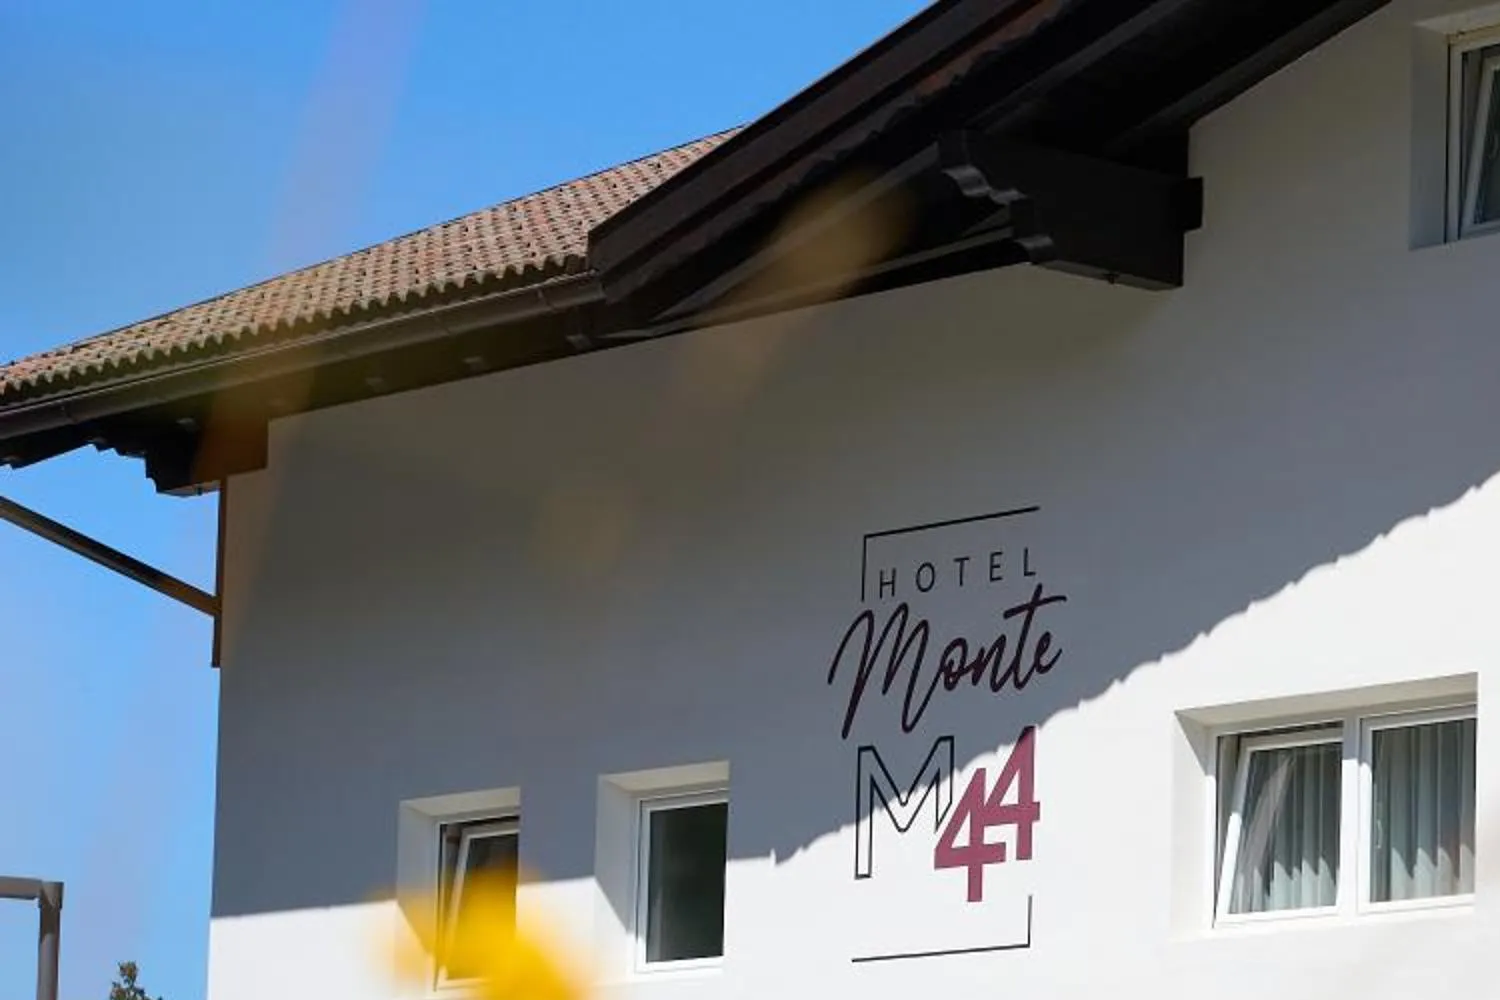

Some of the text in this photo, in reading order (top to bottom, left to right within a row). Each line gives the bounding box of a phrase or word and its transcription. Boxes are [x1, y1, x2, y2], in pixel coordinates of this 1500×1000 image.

[879, 546, 1037, 600] HOTEL
[827, 582, 1068, 740] Monte
[854, 725, 1041, 903] M44
